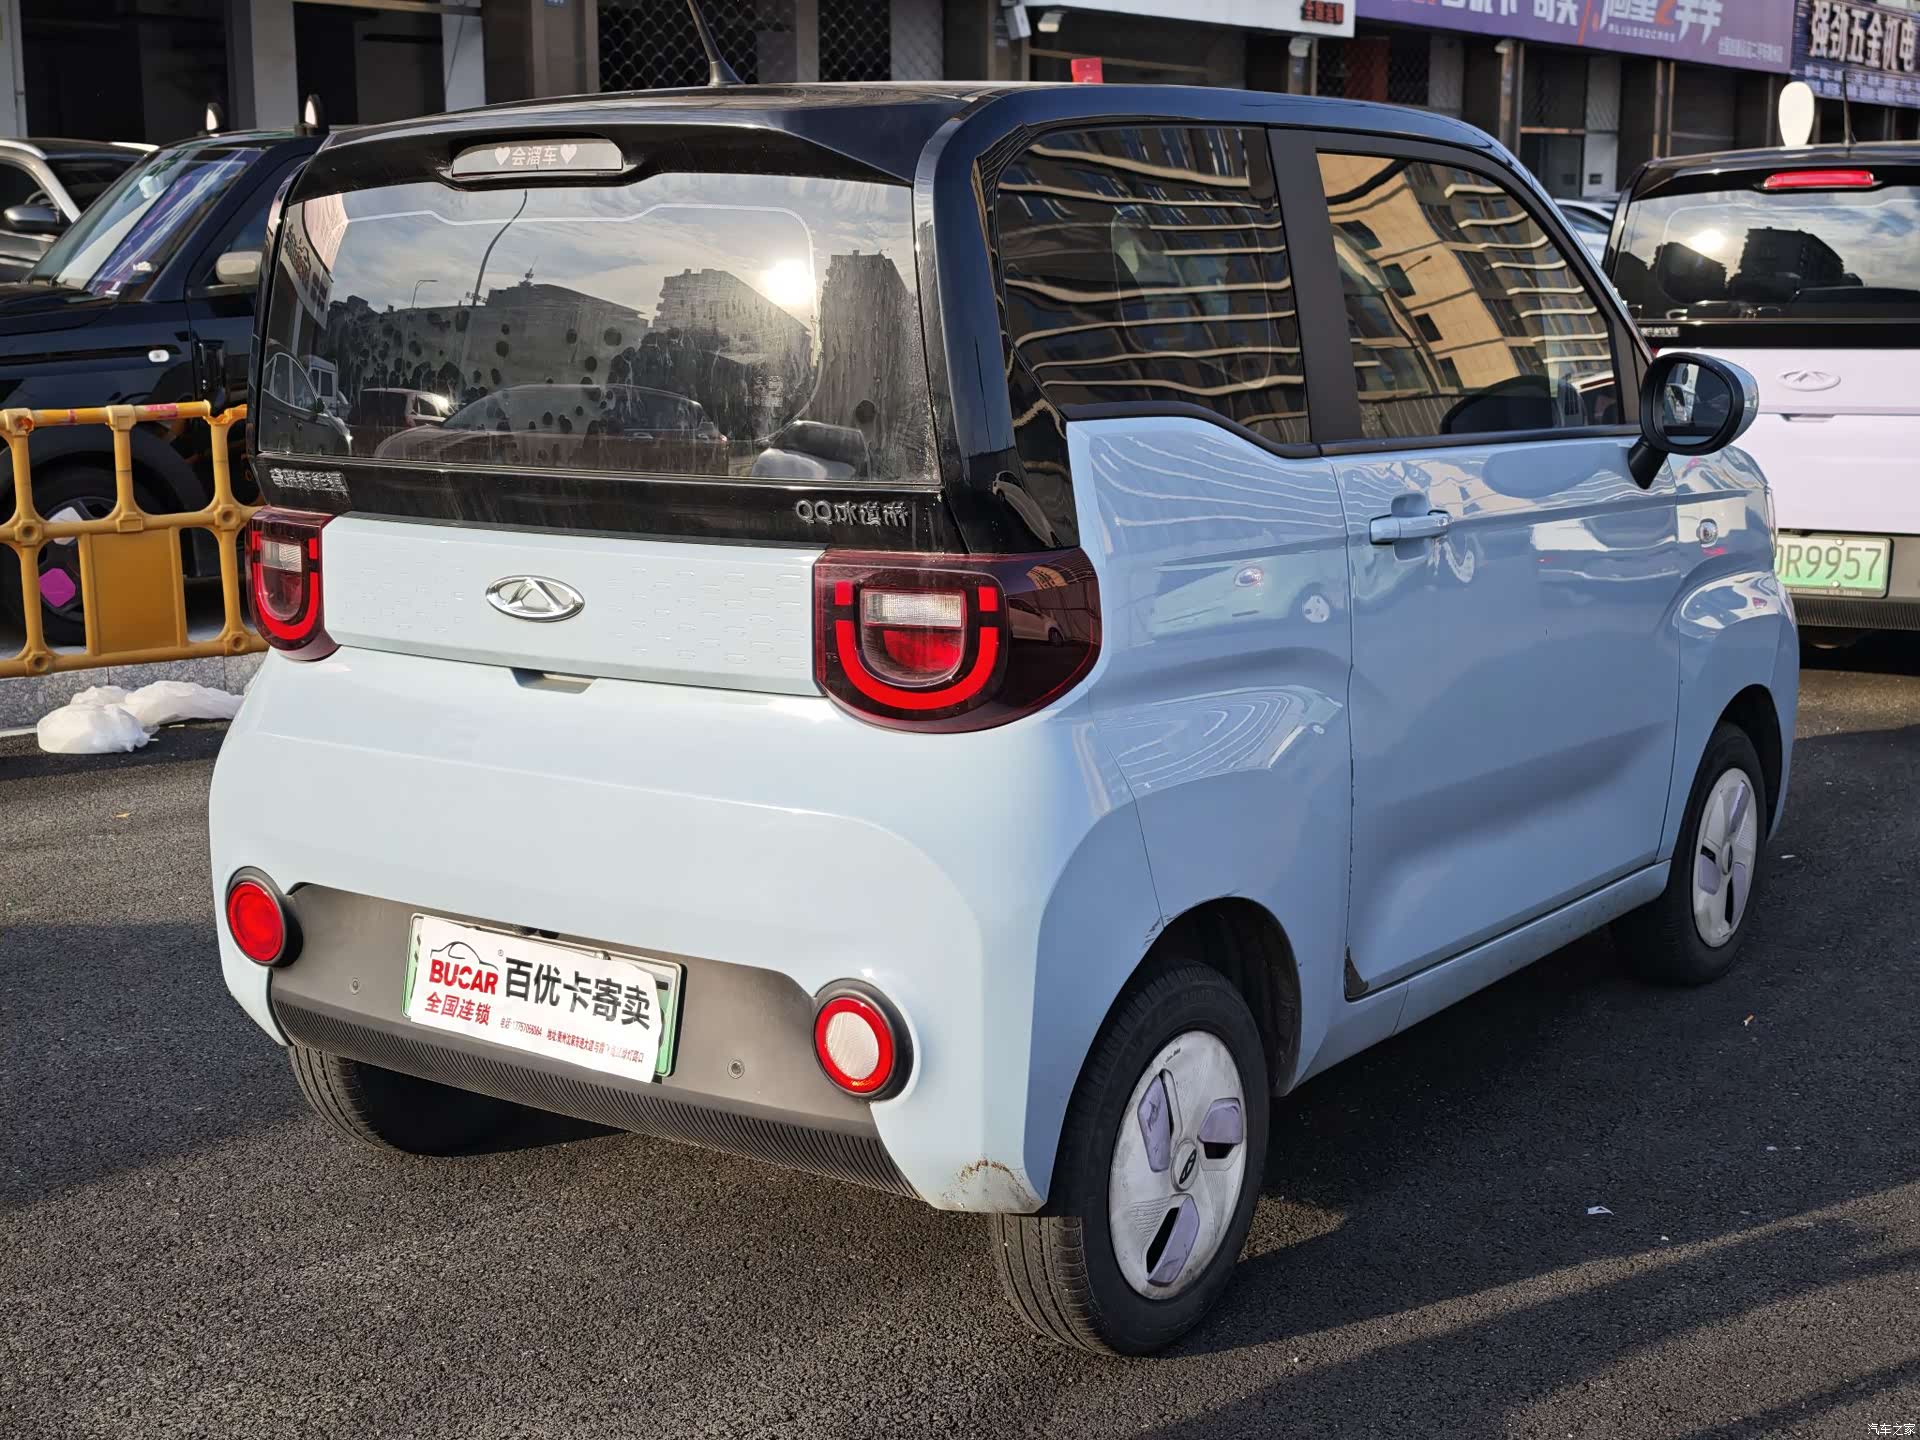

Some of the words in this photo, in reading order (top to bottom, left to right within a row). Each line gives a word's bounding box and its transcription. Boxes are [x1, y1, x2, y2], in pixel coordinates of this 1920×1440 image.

[1809, 0, 1916, 72] 强劲五金机电
[428, 958, 499, 995] BUCAR
[505, 957, 651, 1031] 百优卡寄卖
[424, 991, 492, 1026] 全国连锁
